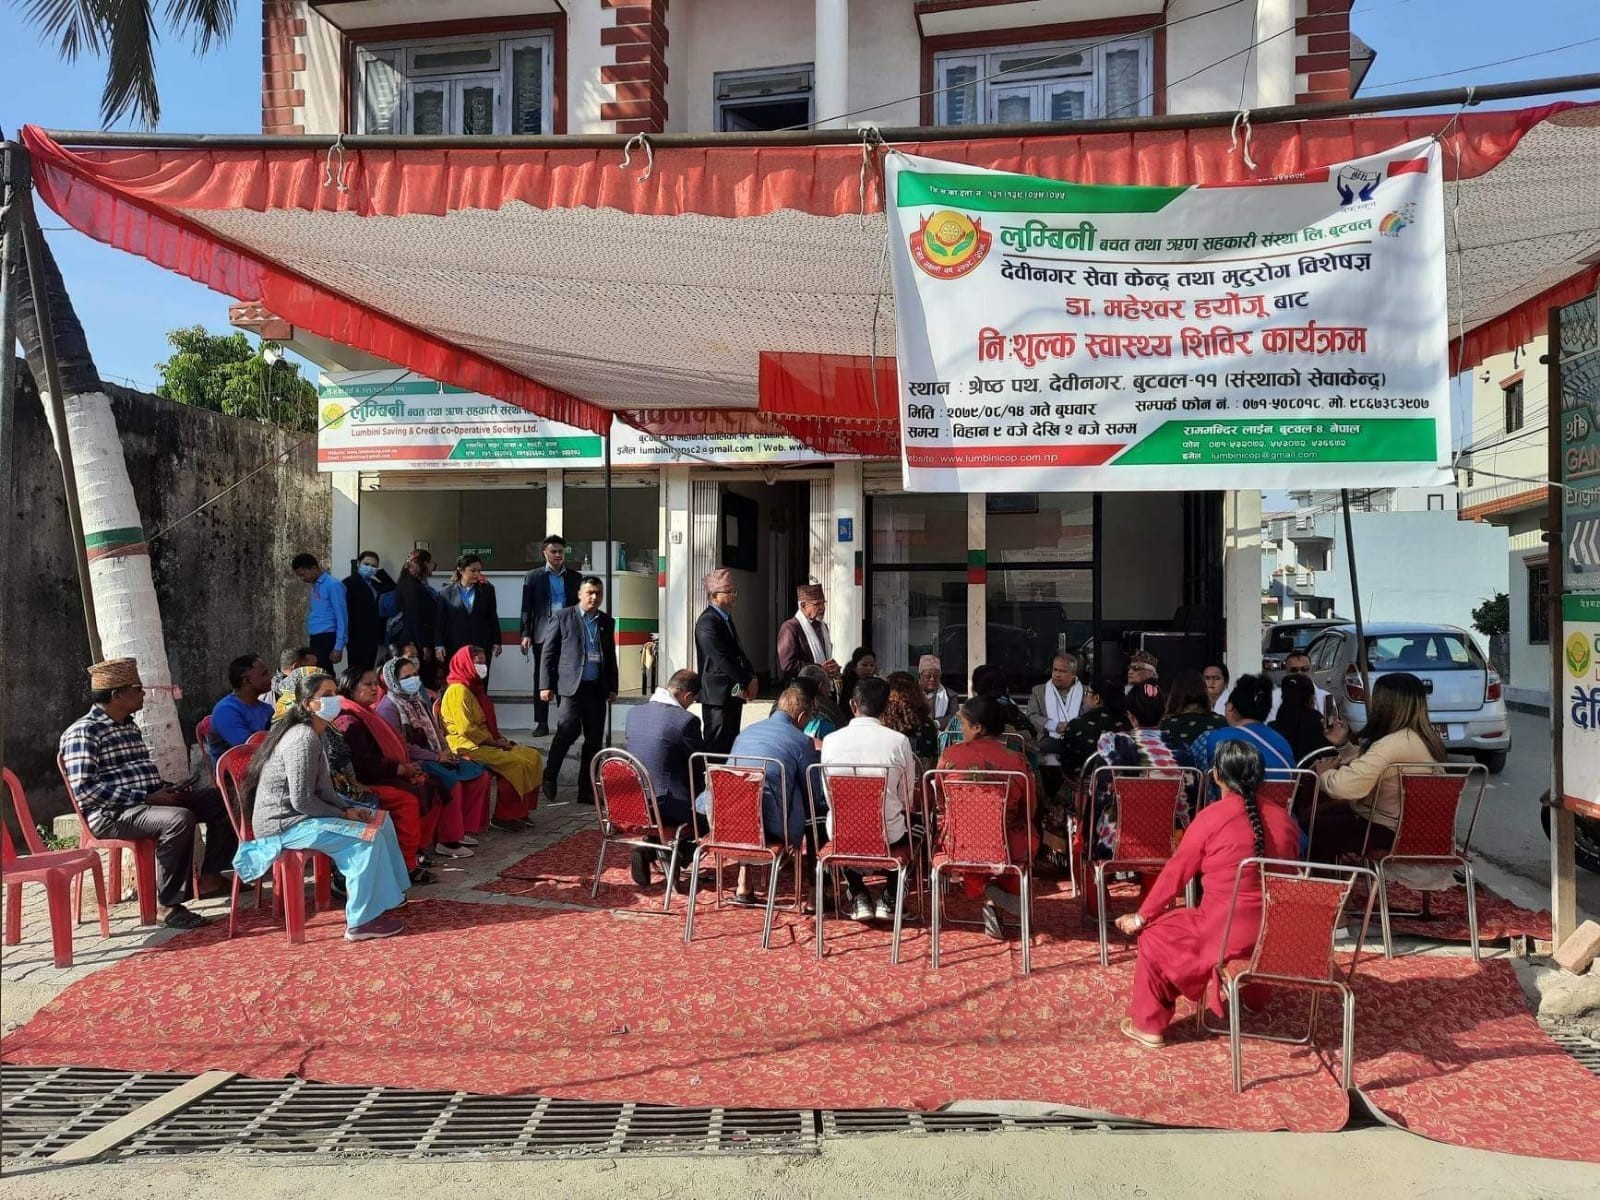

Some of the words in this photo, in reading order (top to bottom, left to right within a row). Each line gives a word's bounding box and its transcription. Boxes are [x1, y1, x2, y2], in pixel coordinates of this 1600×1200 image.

[1000, 219, 1097, 252] लुम्बिनी
[1100, 238, 1129, 251] बचत
[1134, 238, 1162, 252] तथा
[1166, 238, 1198, 252] ऋण
[1202, 232, 1257, 251] सहकारी
[1262, 230, 1298, 249] संस्था
[1329, 218, 1373, 239] बुटवल
[1001, 260, 1077, 285] देवीनगर
[1083, 266, 1118, 287] सेवा
[1124, 267, 1173, 291] केन्द्र
[1177, 271, 1214, 287] तथा
[1222, 263, 1291, 288] मुटुरोग
[1297, 253, 1372, 276] विशेषज्ञ
[1065, 297, 1096, 317] डा.
[1104, 294, 1186, 320] महेश्वर
[1274, 291, 1309, 309] बाट
[1085, 333, 1172, 360] स्वास्थ्य
[1180, 326, 1253, 358] शिविर
[1262, 320, 1368, 356] कार्यक्रम
[908, 381, 951, 396] स्थान
[969, 376, 1005, 395] श्रेष्ठ
[1133, 372, 1218, 393] बुटवल-११
[1225, 368, 1303, 388] (संस्थाको
[1308, 368, 1386, 391] सेवाकेन्द्र)
[350, 400, 406, 422] लुम्बिनी
[908, 404, 935, 419] मिति
[947, 405, 1025, 419] २०७९/०८/१४
[1030, 402, 1051, 417] गते
[1135, 397, 1177, 412] सम्पर्क
[1182, 397, 1211, 411] फोन
[1350, 397, 1430, 411] ९८६७३८३९०७
[351, 425, 381, 437] Lumbini
[382, 425, 407, 437] Saving
[416, 426, 439, 436] Credit
[441, 425, 490, 436] Co-Operative
[492, 424, 521, 436] Society
[523, 424, 538, 434] Ltd.
[908, 426, 940, 438] समय
[994, 425, 1002, 437] ९
[1033, 421, 1061, 437] देखि
[1065, 424, 1073, 435] २
[1078, 420, 1100, 436] बजे
[1105, 423, 1138, 436] सम्म
[1183, 423, 1239, 436] राममन्दिर
[1330, 422, 1361, 435] नेपाल
[764, 443, 785, 453] Web.
[941, 453, 1059, 465] www.lumbinicop.com.np
